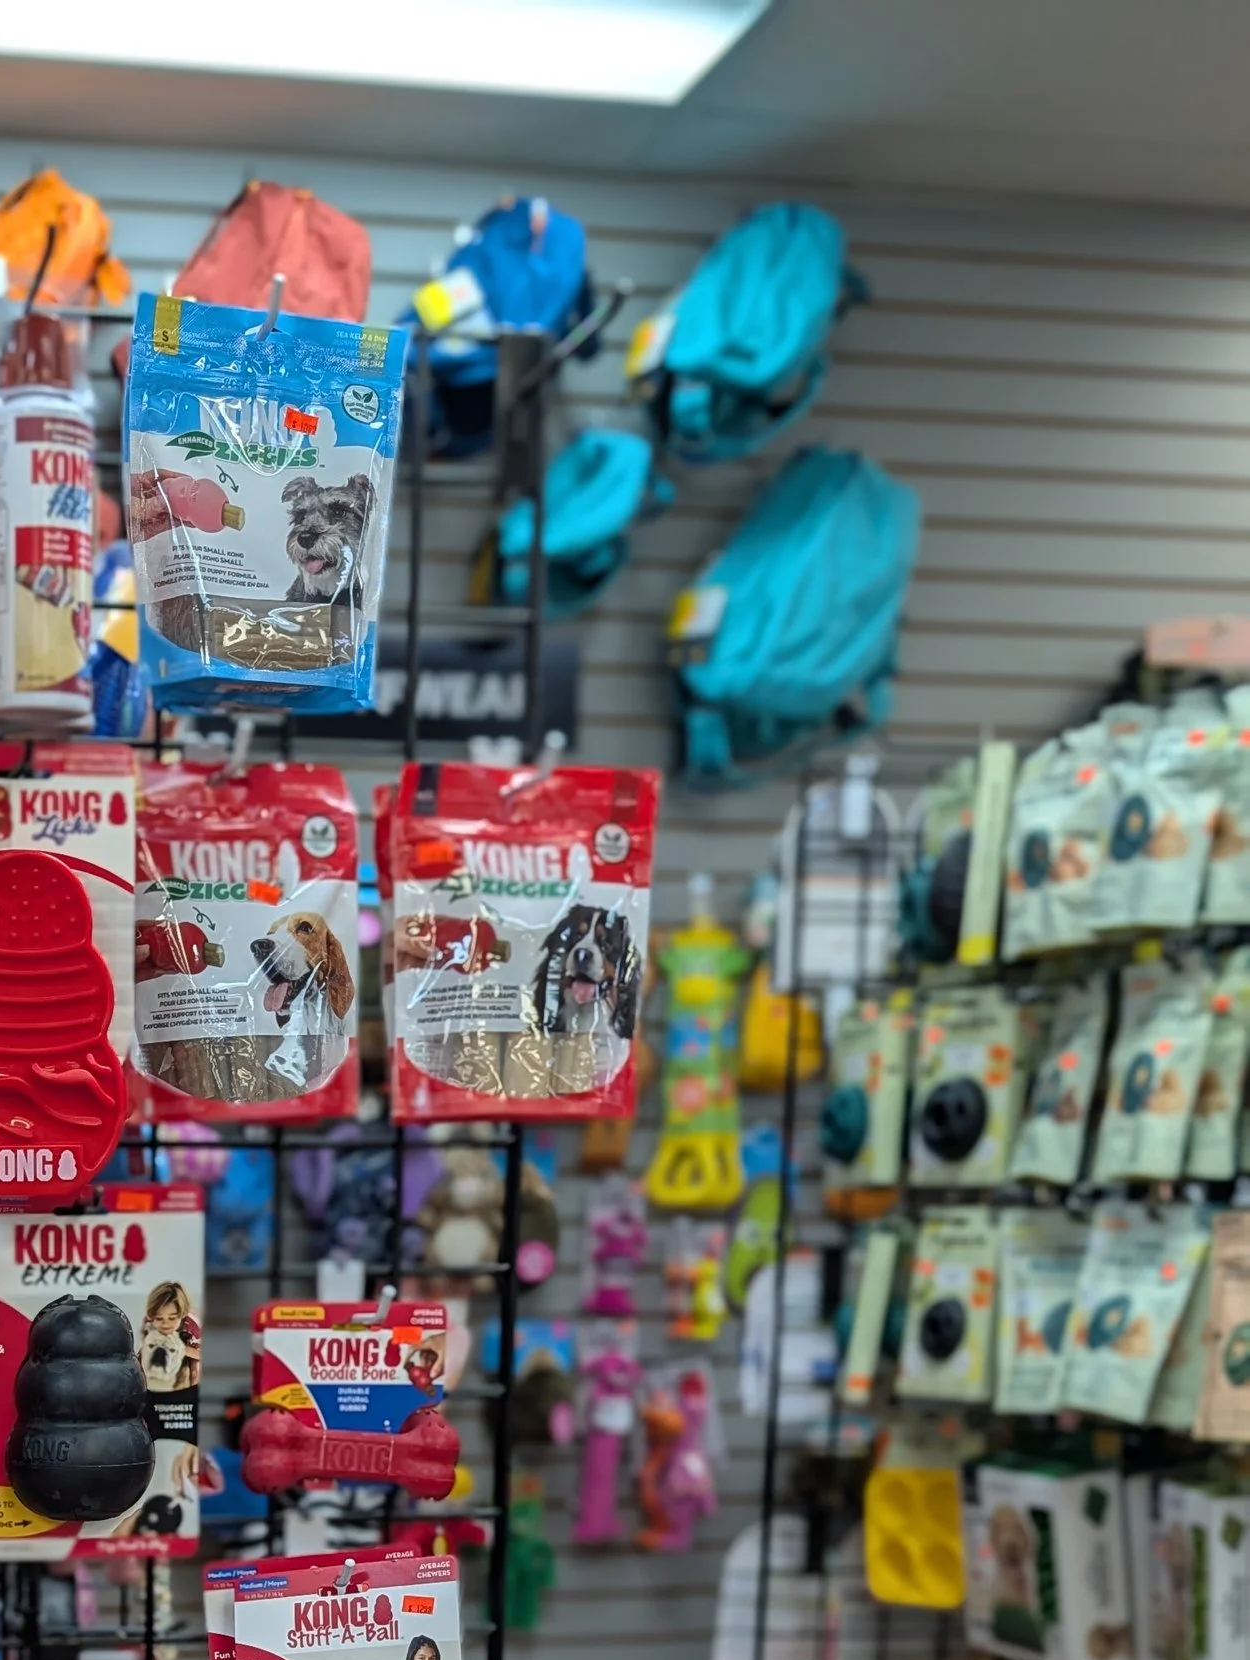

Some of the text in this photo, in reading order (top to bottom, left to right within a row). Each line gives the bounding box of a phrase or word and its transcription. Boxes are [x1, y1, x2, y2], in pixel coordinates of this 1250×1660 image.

[178, 437, 213, 448] ENHANCED
[214, 440, 319, 467] ZIGGIES
[203, 546, 226, 556] SMALL
[20, 790, 101, 826] KONG
[32, 816, 96, 840] Licks
[170, 839, 270, 883] KONG
[463, 840, 561, 881] KONG
[190, 883, 246, 900] ZIGG
[483, 879, 575, 898] ZIGGIES
[14, 1224, 114, 1265] KONG
[21, 1264, 134, 1286] EXTREME
[309, 1338, 379, 1367] KONG
[311, 1365, 396, 1380] Goodie Bone
[324, 1442, 389, 1473] KONG
[417, 1569, 450, 1578] CHEWERS
[419, 1561, 450, 1570] AVERAGE
[293, 1596, 368, 1633] KONG
[287, 1620, 399, 1649] Stuff-A-Ball
